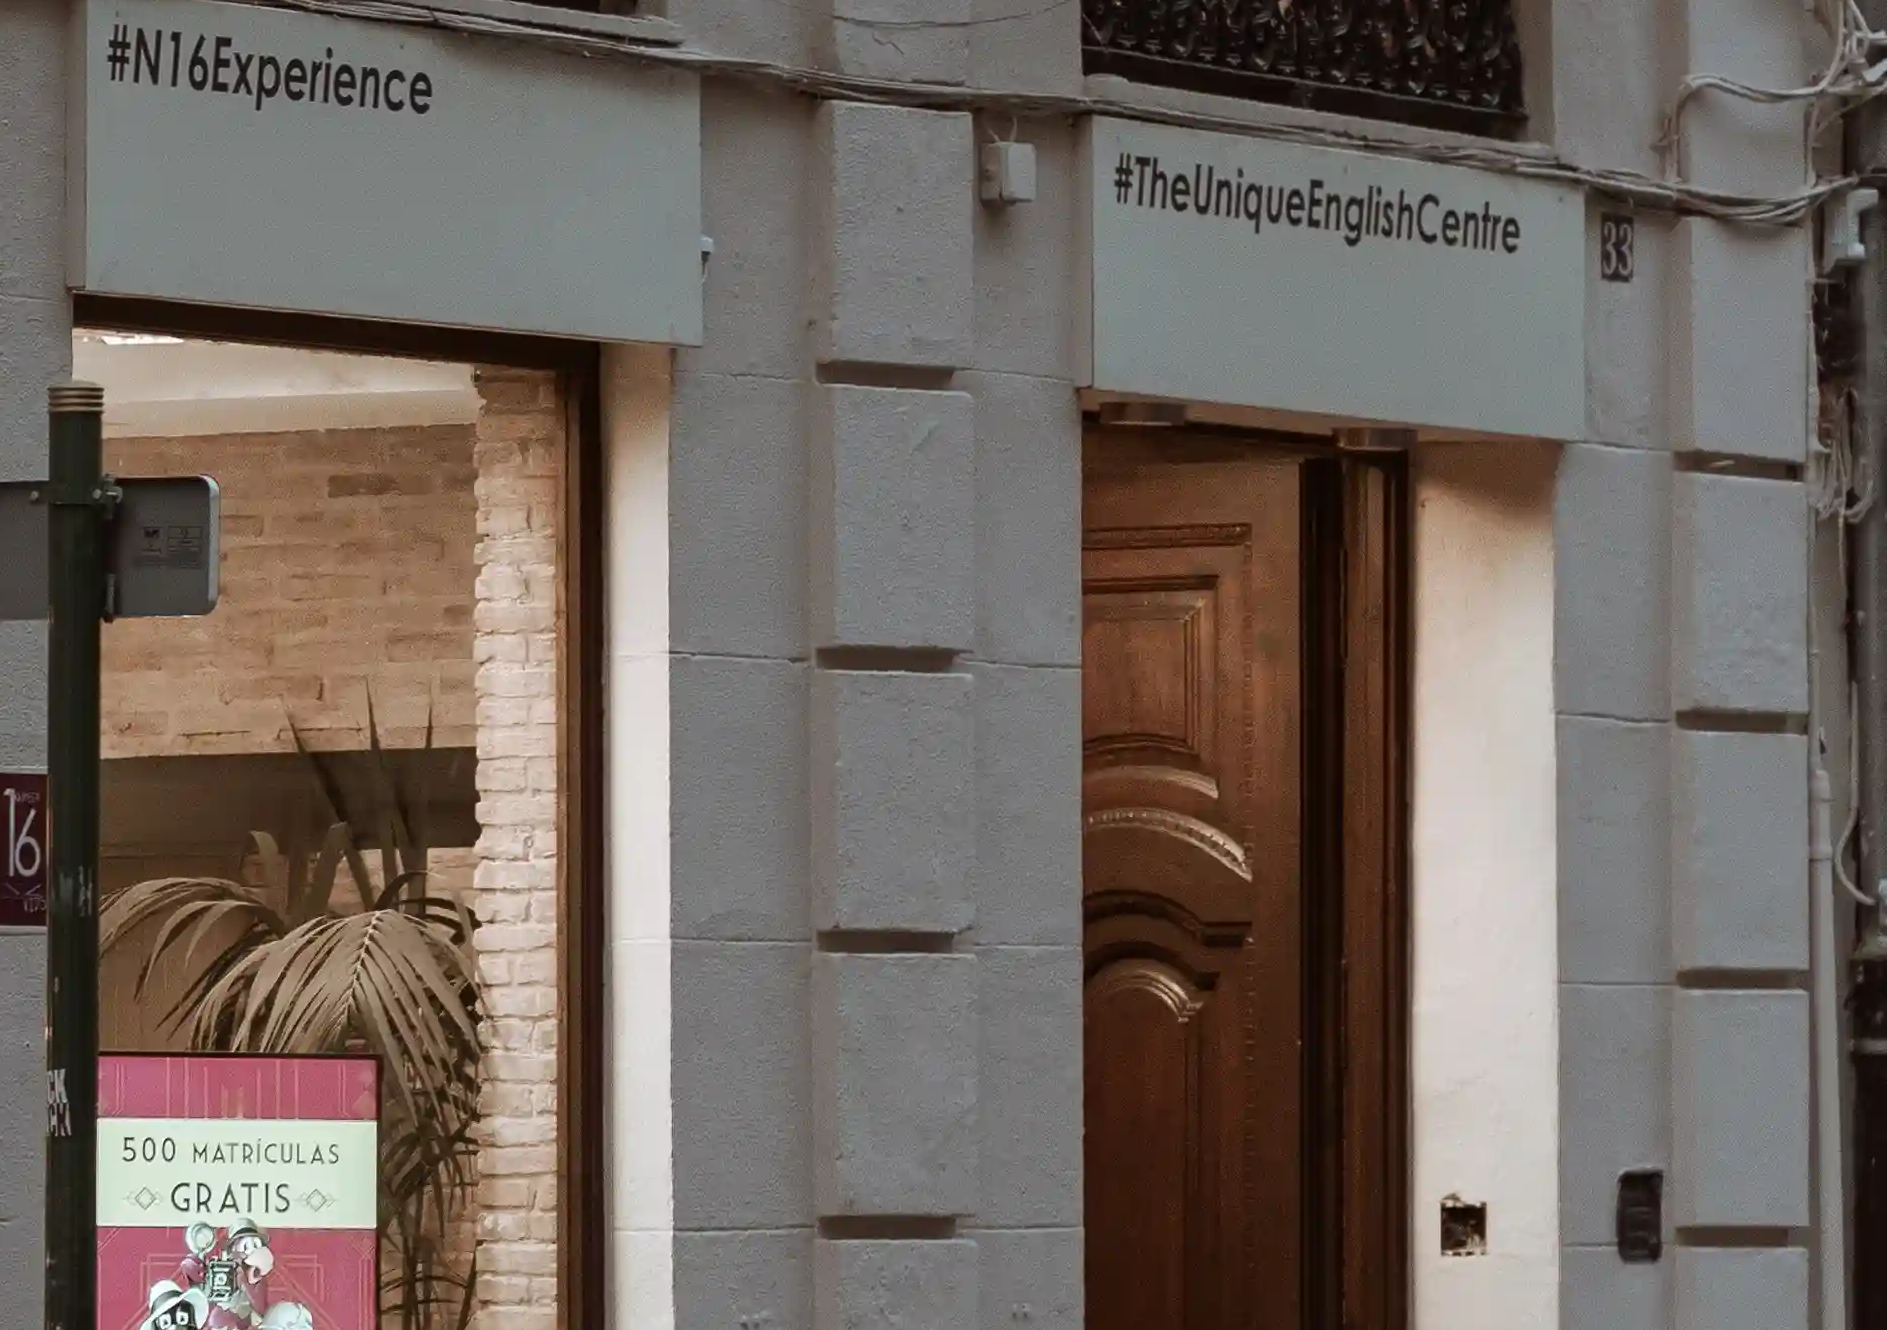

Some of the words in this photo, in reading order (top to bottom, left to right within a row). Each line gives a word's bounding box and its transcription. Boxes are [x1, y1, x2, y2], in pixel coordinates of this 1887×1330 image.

[106, 23, 434, 115] #N16Experience
[1114, 152, 1522, 255] #TheUniqueEnglishCentre
[1603, 221, 1632, 276] 33
[3, 788, 42, 878] 16
[122, 1136, 176, 1163] 500
[192, 1138, 340, 1165] MATRÍCULAS
[170, 1182, 291, 1214] GRATIS
